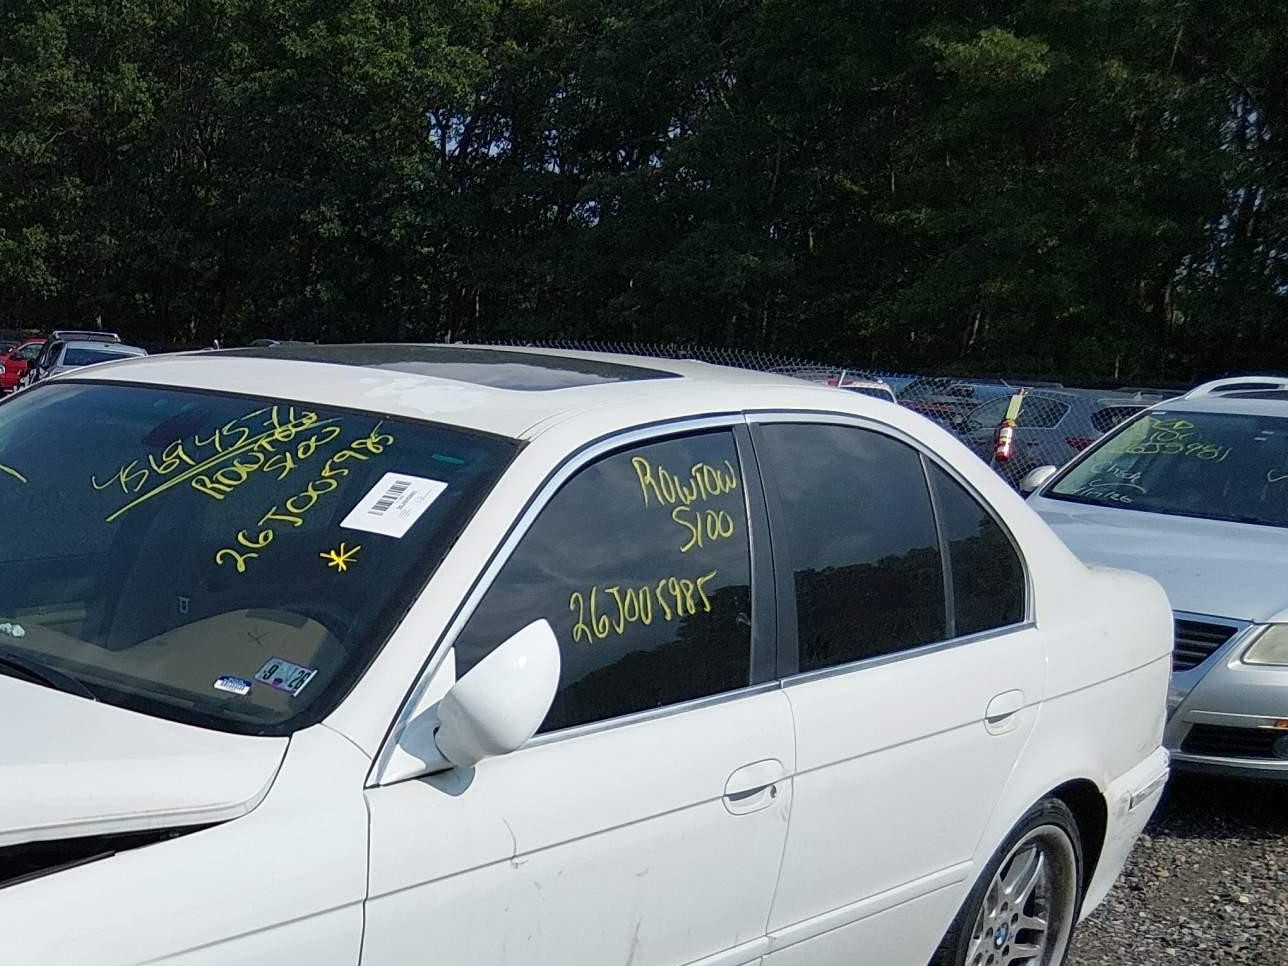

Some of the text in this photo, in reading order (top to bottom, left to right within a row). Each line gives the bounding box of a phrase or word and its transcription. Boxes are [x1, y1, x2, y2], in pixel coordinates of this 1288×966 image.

[631, 456, 737, 508] ROWTOW
[672, 506, 734, 552] S100
[570, 569, 718, 644] 26J005985
